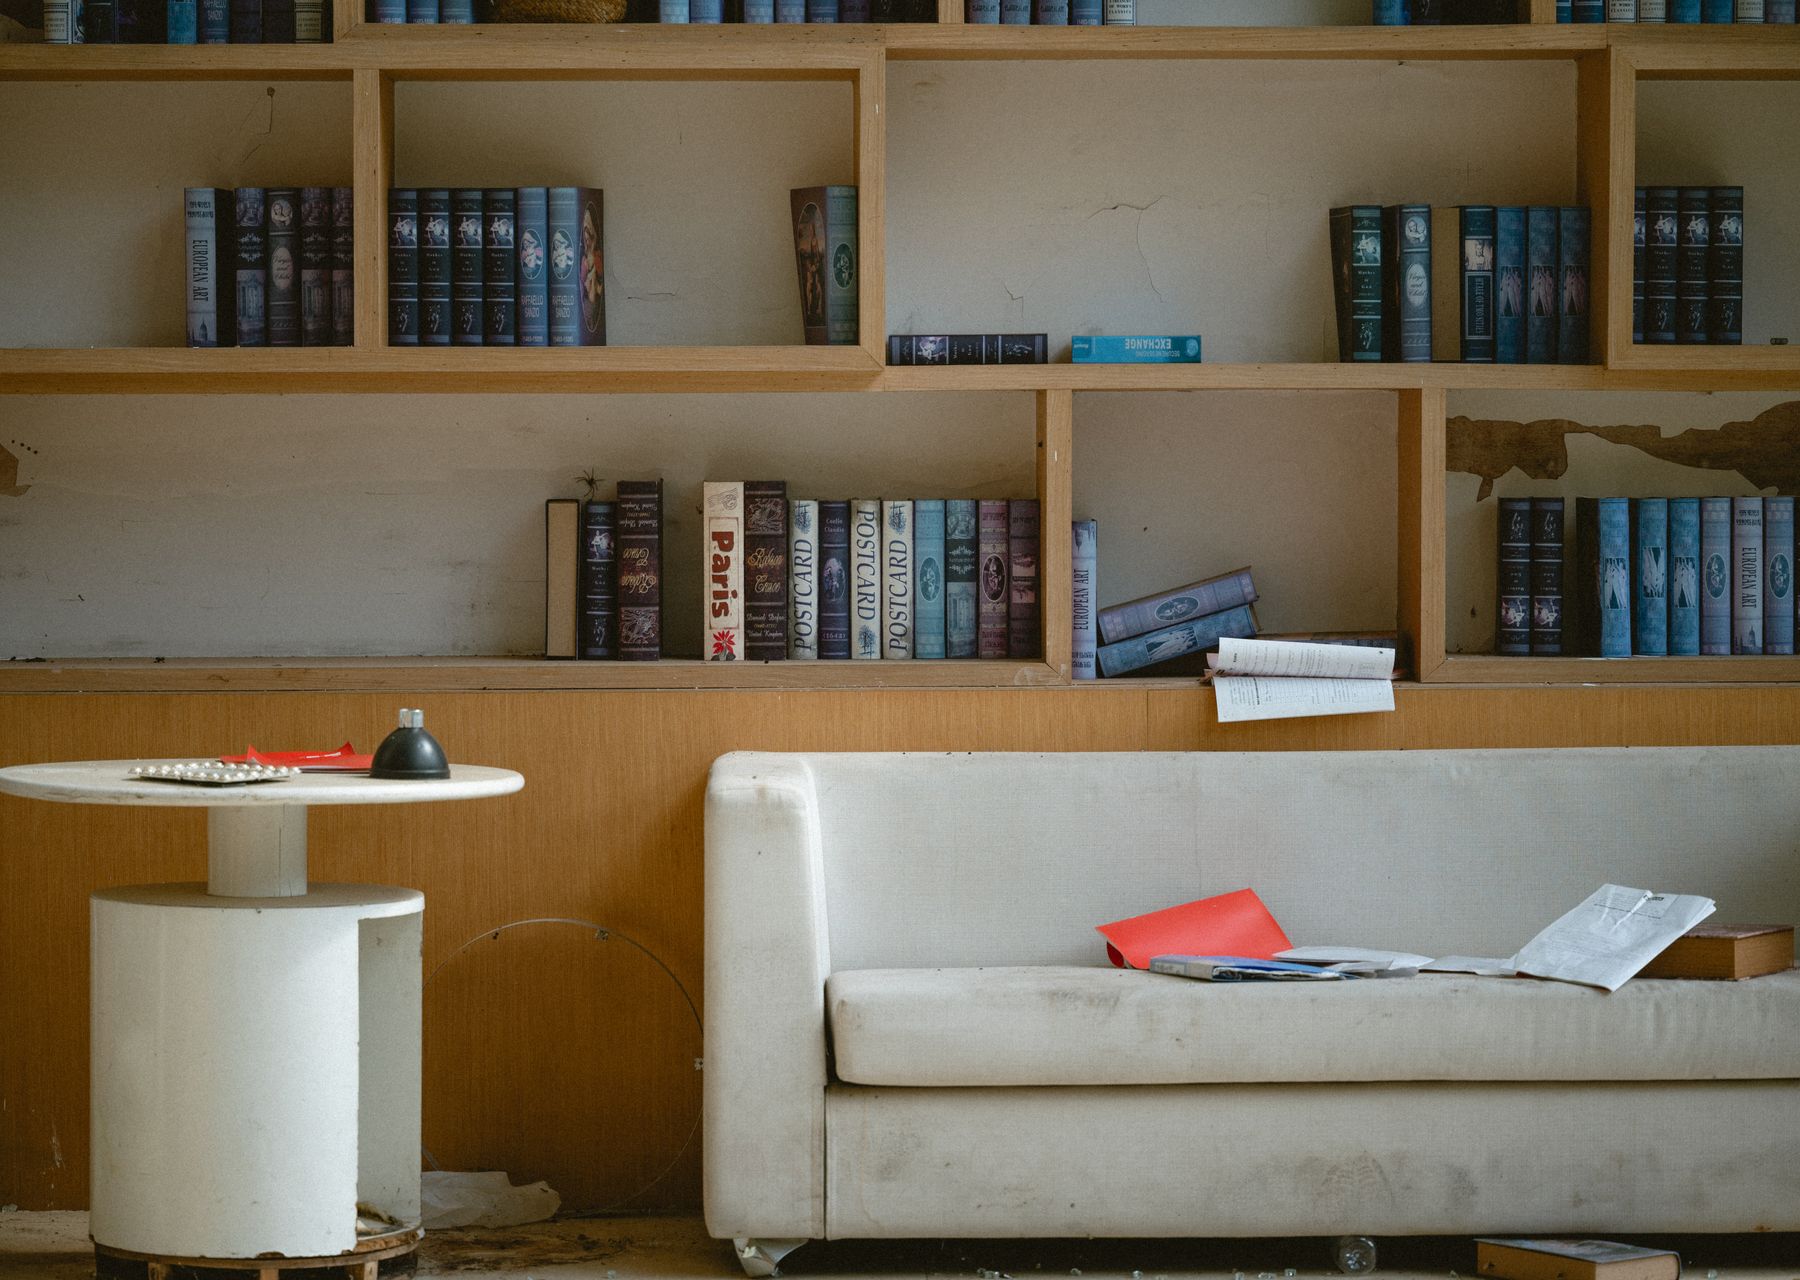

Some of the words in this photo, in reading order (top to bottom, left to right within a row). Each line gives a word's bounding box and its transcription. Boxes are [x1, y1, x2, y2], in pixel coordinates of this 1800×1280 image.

[192, 240, 208, 284] EUROPEAN
[193, 287, 208, 301] ART
[524, 307, 540, 318] SANZIO
[555, 307, 571, 318] SANZIO
[1124, 338, 1172, 349] EXCHANGE
[712, 531, 738, 618] Paris
[856, 510, 876, 621] POSTCARD
[1073, 569, 1089, 583] ART
[1742, 547, 1757, 590] EUROPEAN
[794, 538, 813, 651] POSTCARD
[889, 539, 908, 652] POSTCARD
[1073, 588, 1088, 630] EUROPEAN
[1742, 593, 1757, 608] ART
